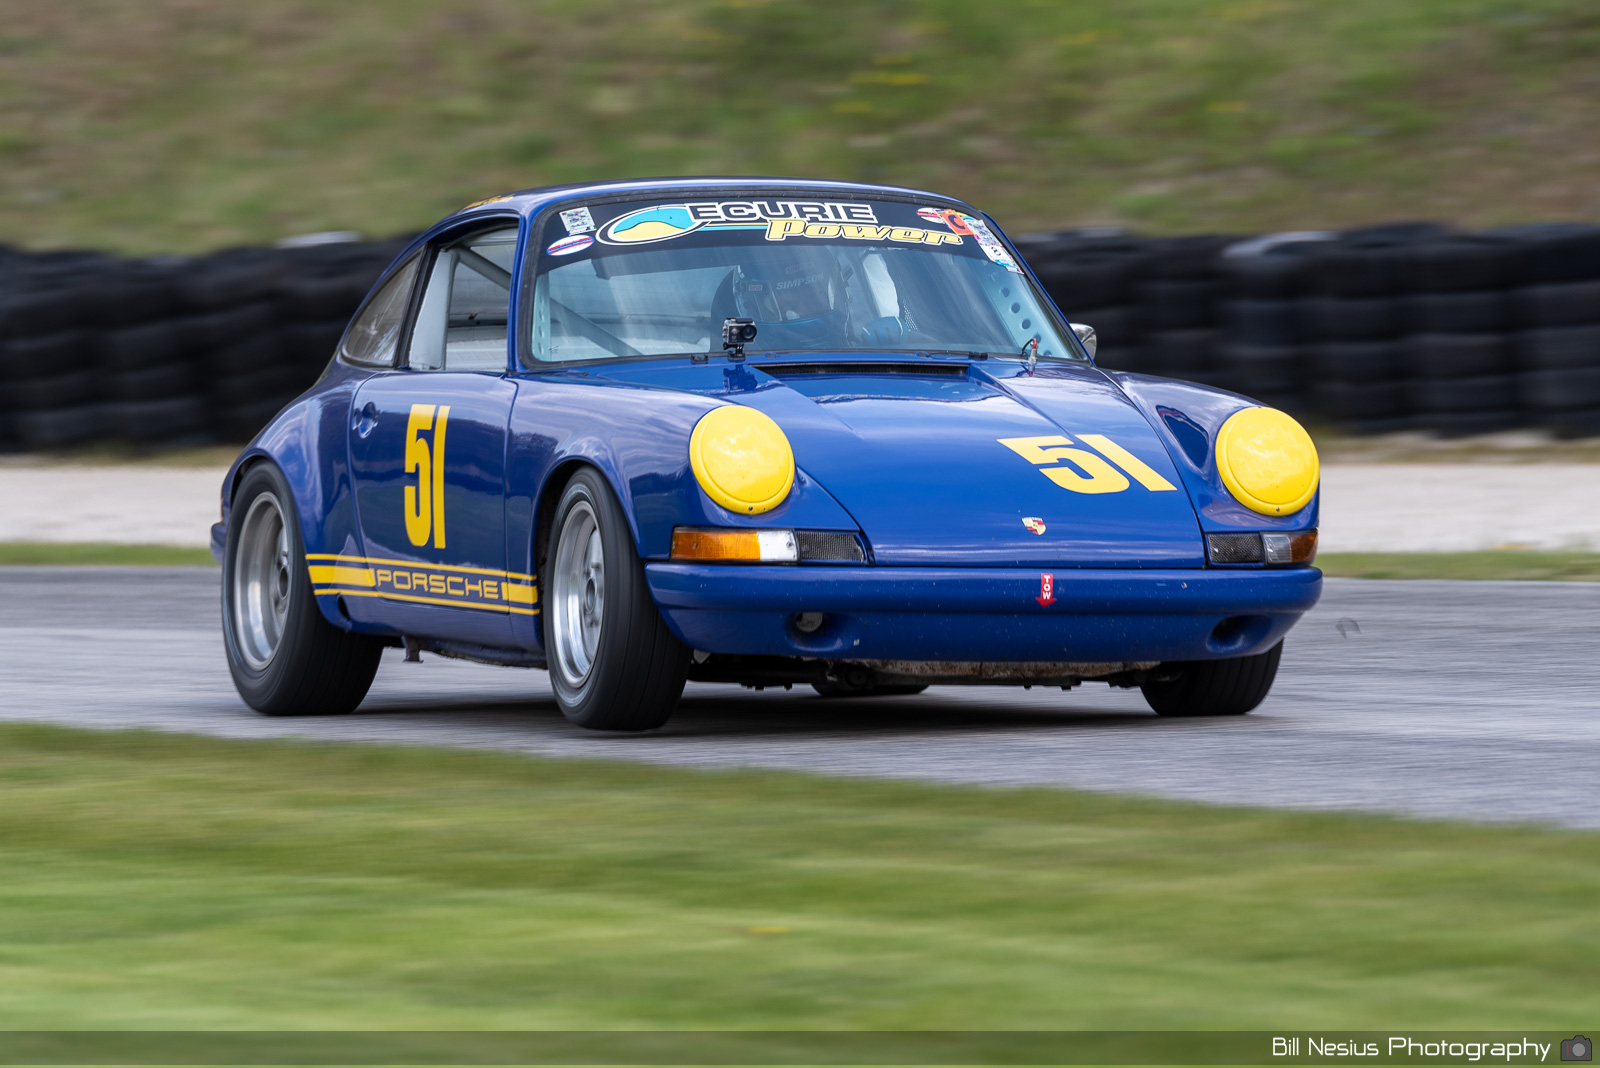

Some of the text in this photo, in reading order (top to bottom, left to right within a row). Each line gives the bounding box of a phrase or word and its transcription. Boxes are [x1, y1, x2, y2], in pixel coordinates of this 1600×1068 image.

[687, 201, 877, 223] ECURIE
[776, 273, 824, 290] SIMPSON
[404, 403, 450, 549] 51
[996, 434, 1178, 494] 51
[377, 569, 499, 599] PORSCHE
[1042, 575, 1052, 600] TOW
